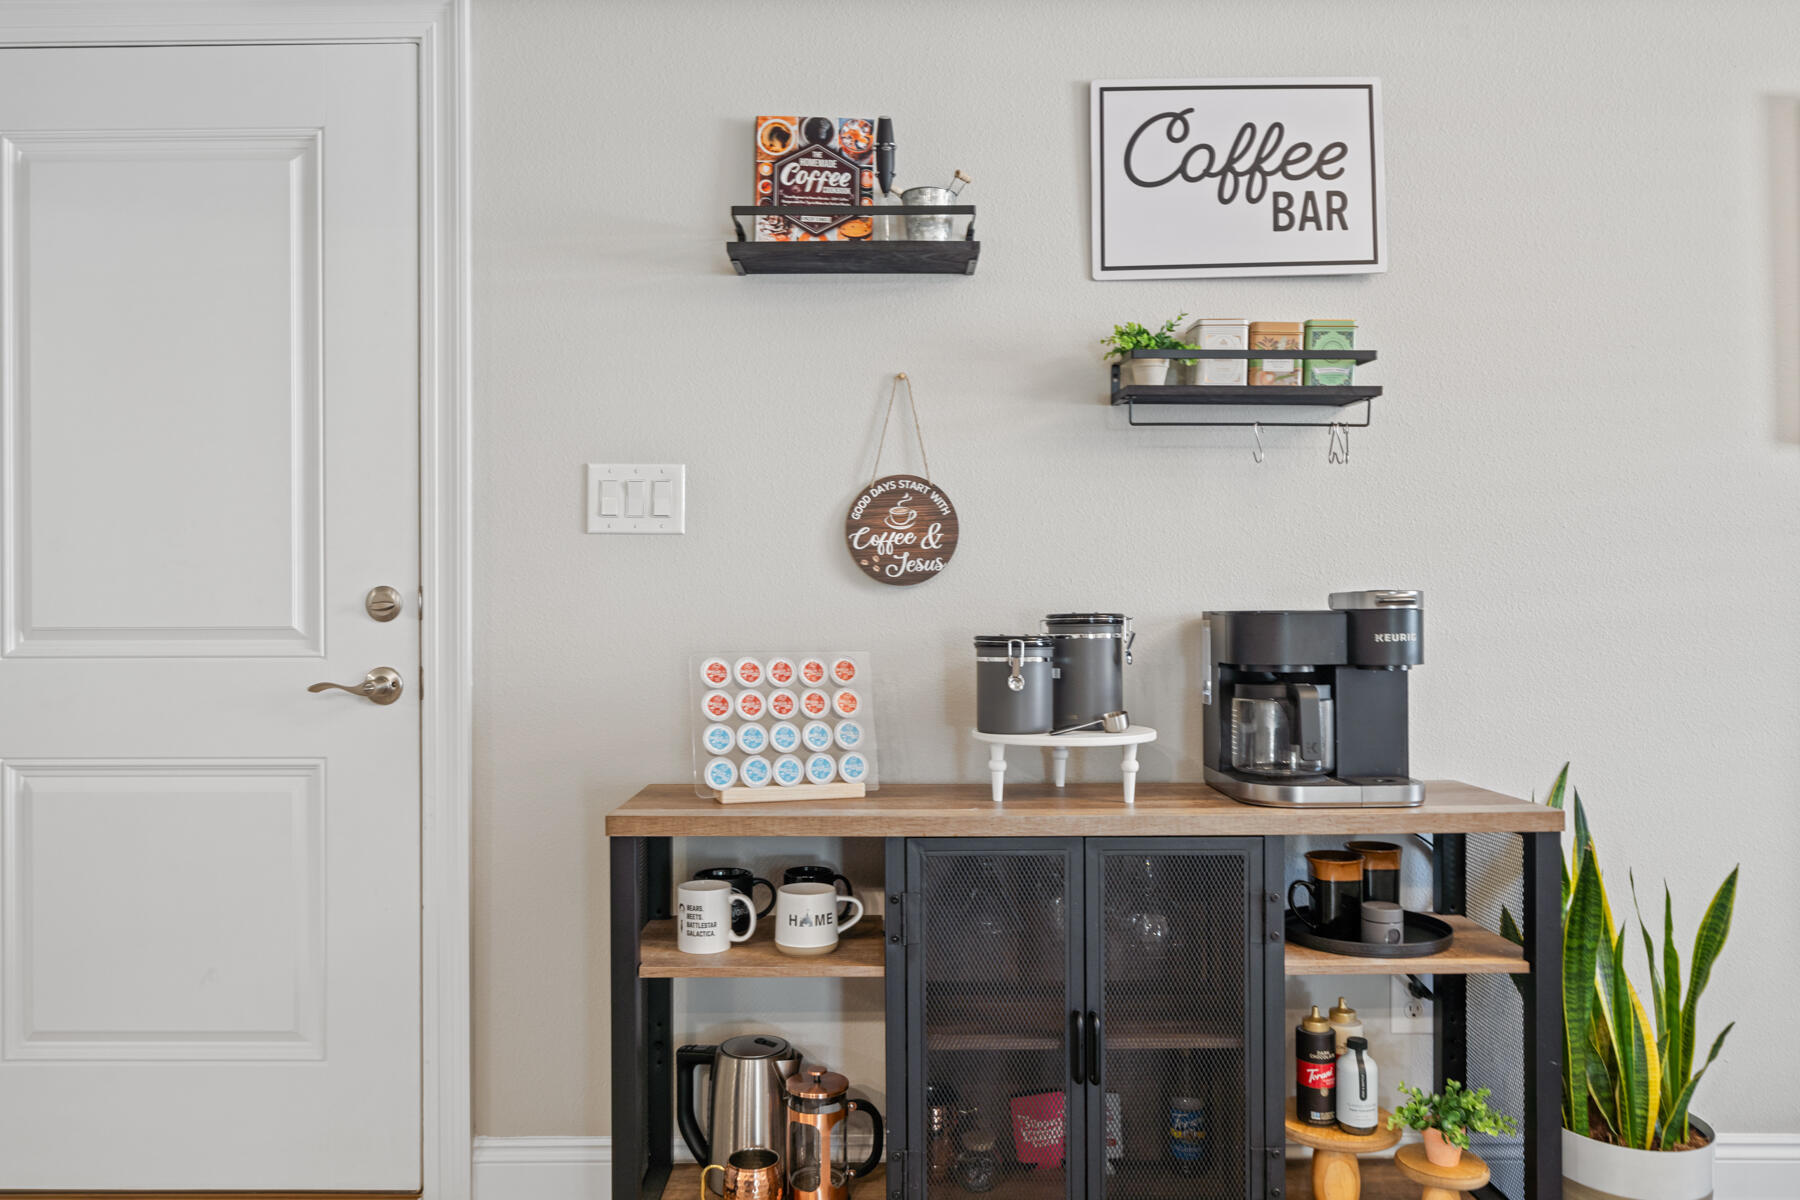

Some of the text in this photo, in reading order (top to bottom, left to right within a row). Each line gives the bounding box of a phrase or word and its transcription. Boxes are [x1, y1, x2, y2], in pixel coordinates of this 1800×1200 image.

[1124, 107, 1348, 205] Coffee
[780, 162, 852, 193] Coffee
[1272, 190, 1349, 232] BAR
[851, 479, 951, 520] GOOD DAYS START WITH
[848, 522, 945, 556] Coffee &
[885, 551, 945, 578] Jesus
[1374, 633, 1417, 643] KEURIG
[789, 911, 833, 927] HME
